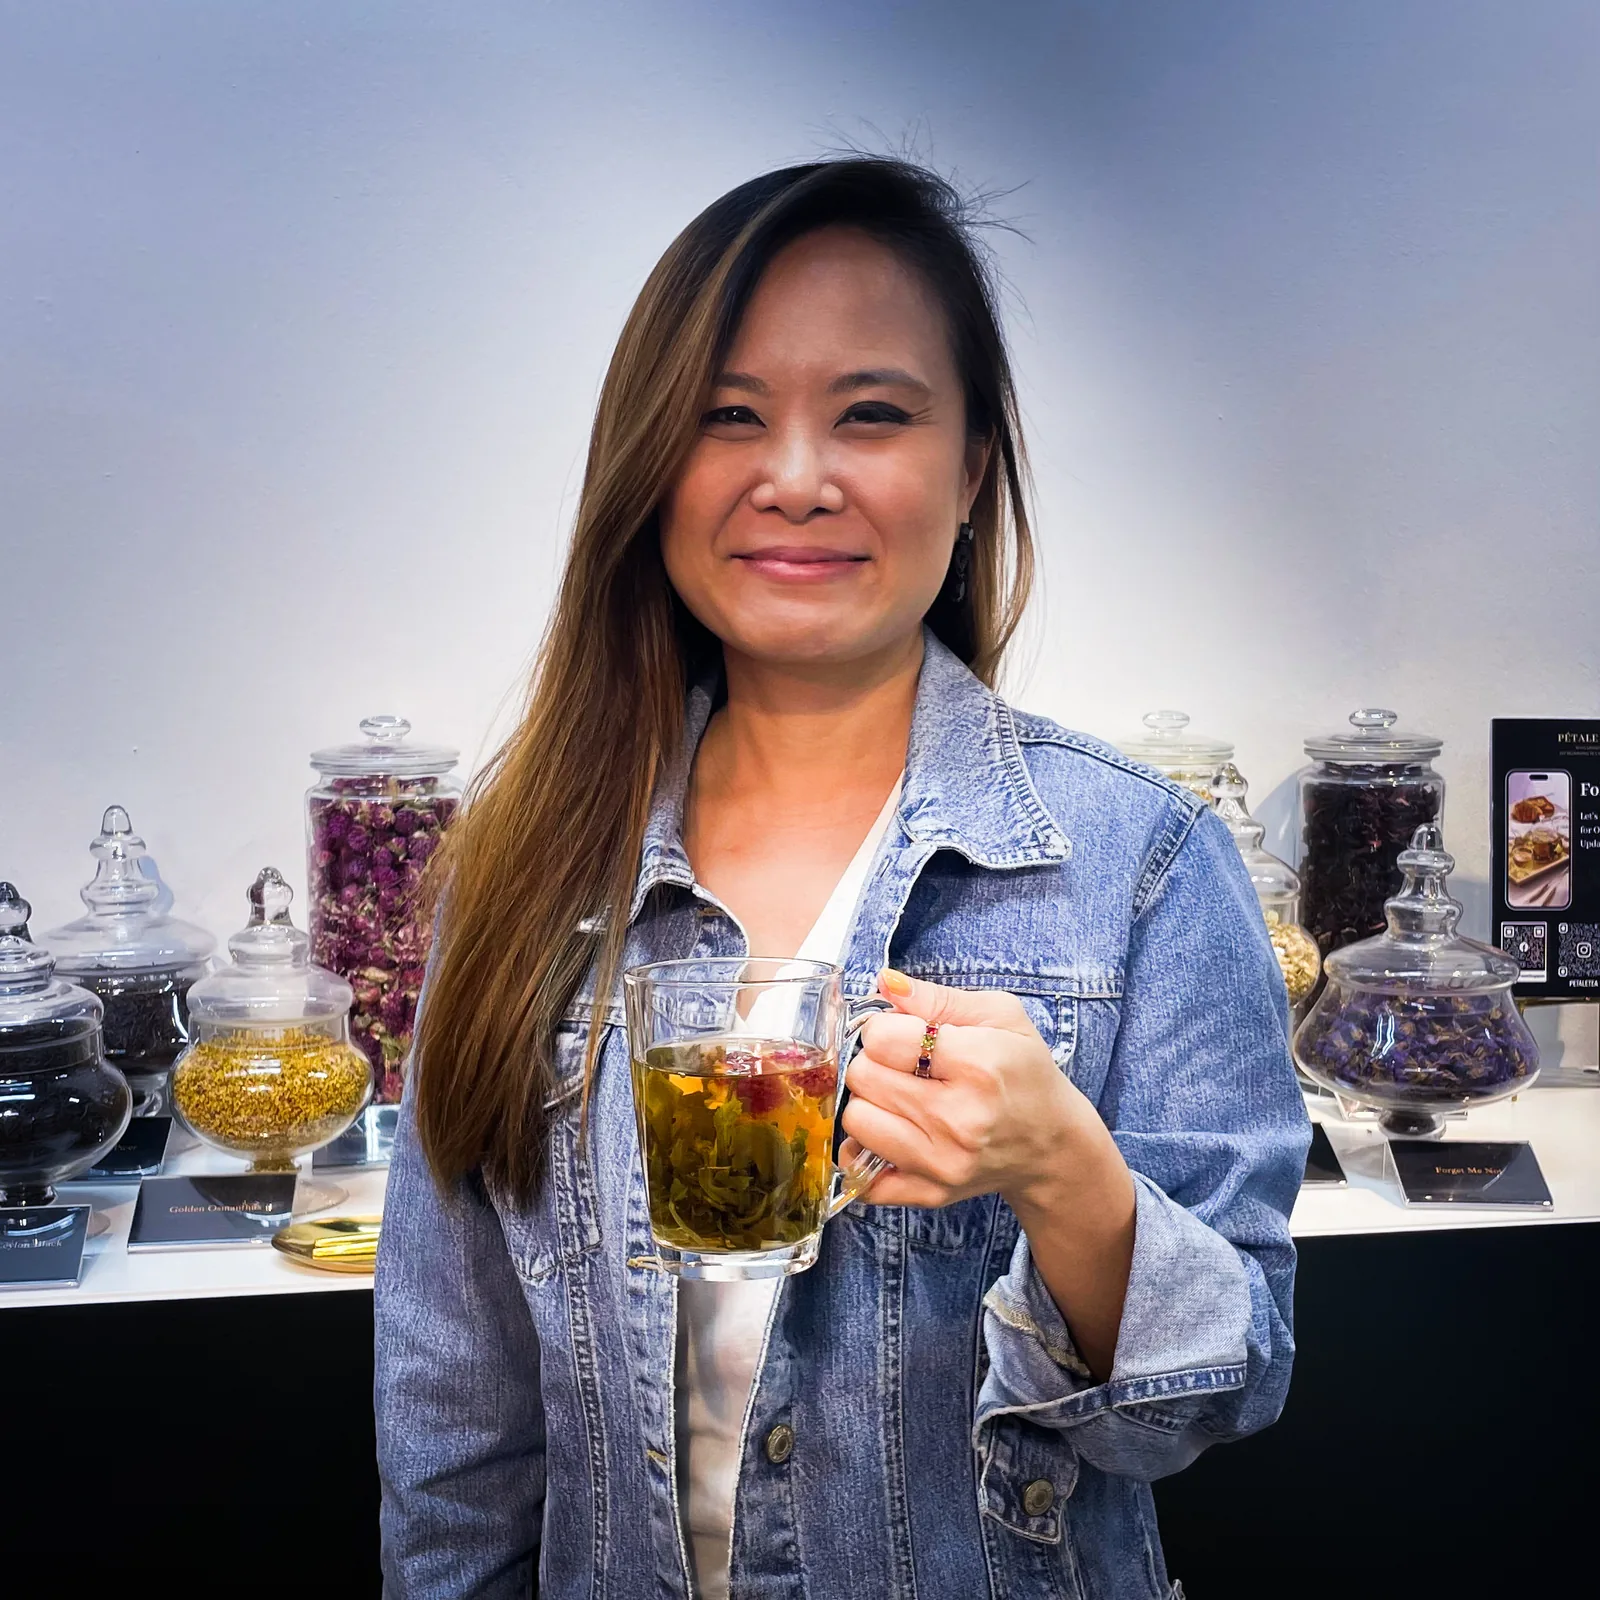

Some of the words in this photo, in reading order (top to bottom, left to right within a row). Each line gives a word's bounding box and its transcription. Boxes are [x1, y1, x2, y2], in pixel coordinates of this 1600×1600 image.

[1557, 731, 1599, 743] PÉTALE
[1580, 811, 1599, 821] Let's
[1580, 825, 1592, 835] for
[1435, 1166, 1465, 1175] Forget
[1467, 1166, 1483, 1175] Me
[169, 1205, 205, 1214] Golden
